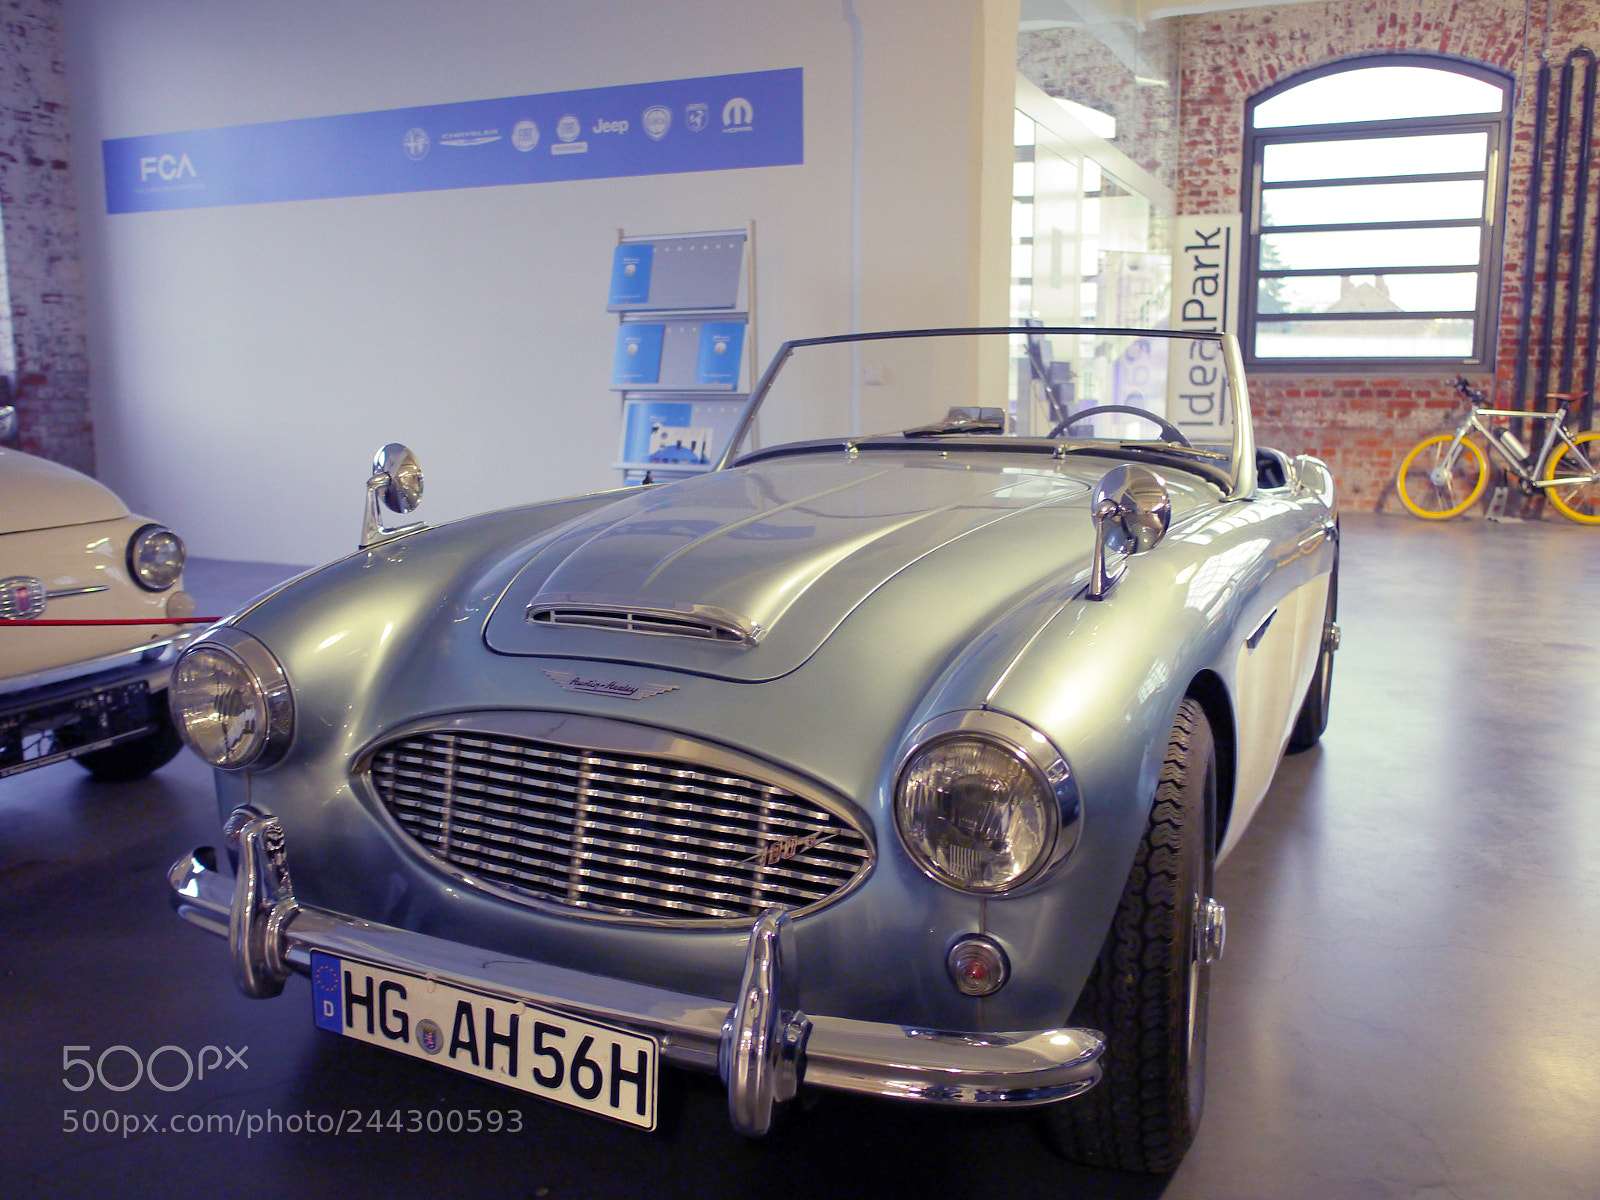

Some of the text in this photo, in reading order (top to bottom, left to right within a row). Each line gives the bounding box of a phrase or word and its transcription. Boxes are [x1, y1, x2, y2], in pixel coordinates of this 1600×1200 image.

[592, 118, 629, 135] Jeep
[141, 153, 196, 181] FCA
[323, 1000, 334, 1017] D
[344, 970, 648, 1116] HG AH 56H
